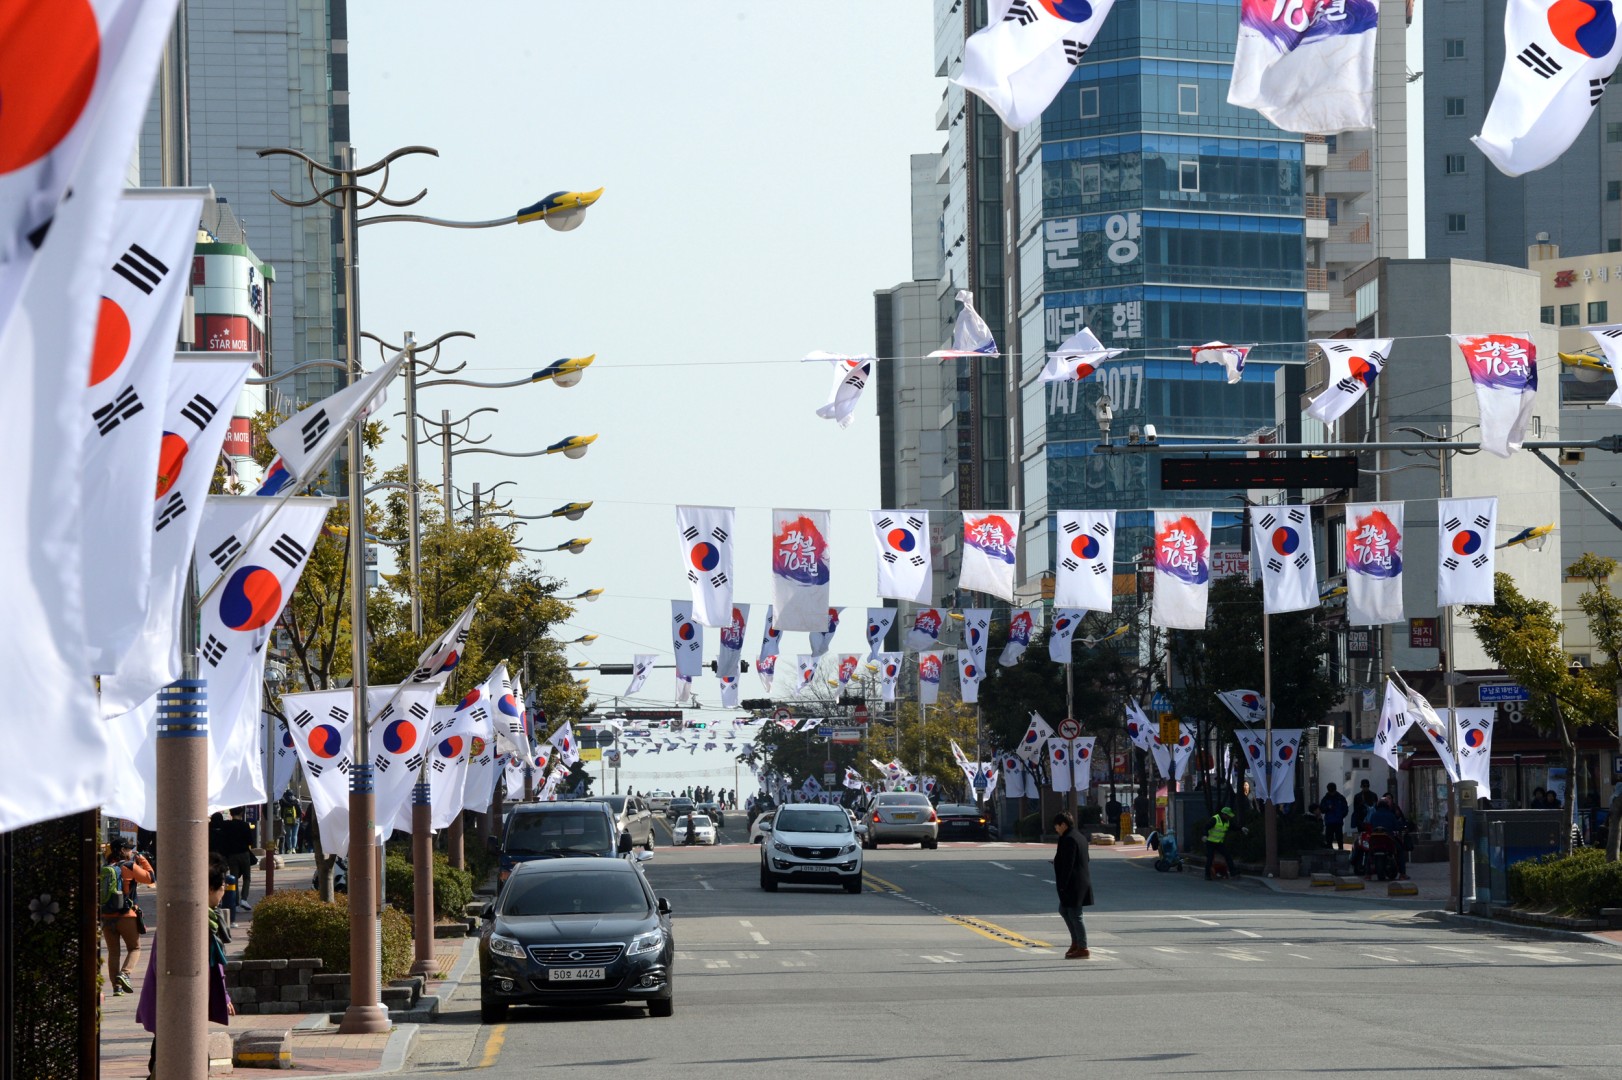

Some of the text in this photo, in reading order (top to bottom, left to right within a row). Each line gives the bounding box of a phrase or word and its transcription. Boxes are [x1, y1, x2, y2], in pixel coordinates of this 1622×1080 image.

[1045, 212, 1141, 268] 분양
[210, 339, 230, 349] STAR
[1474, 341, 1529, 367] 광복
[780, 531, 816, 564] 광복
[1164, 529, 1198, 563] 광복
[1355, 524, 1390, 557] 광복
[1162, 546, 1199, 575] 70주년
[1354, 544, 1392, 569] 70주년
[1412, 627, 1432, 635] 돼지
[1413, 637, 1432, 646] 국밥
[576, 969, 601, 978] 4424
